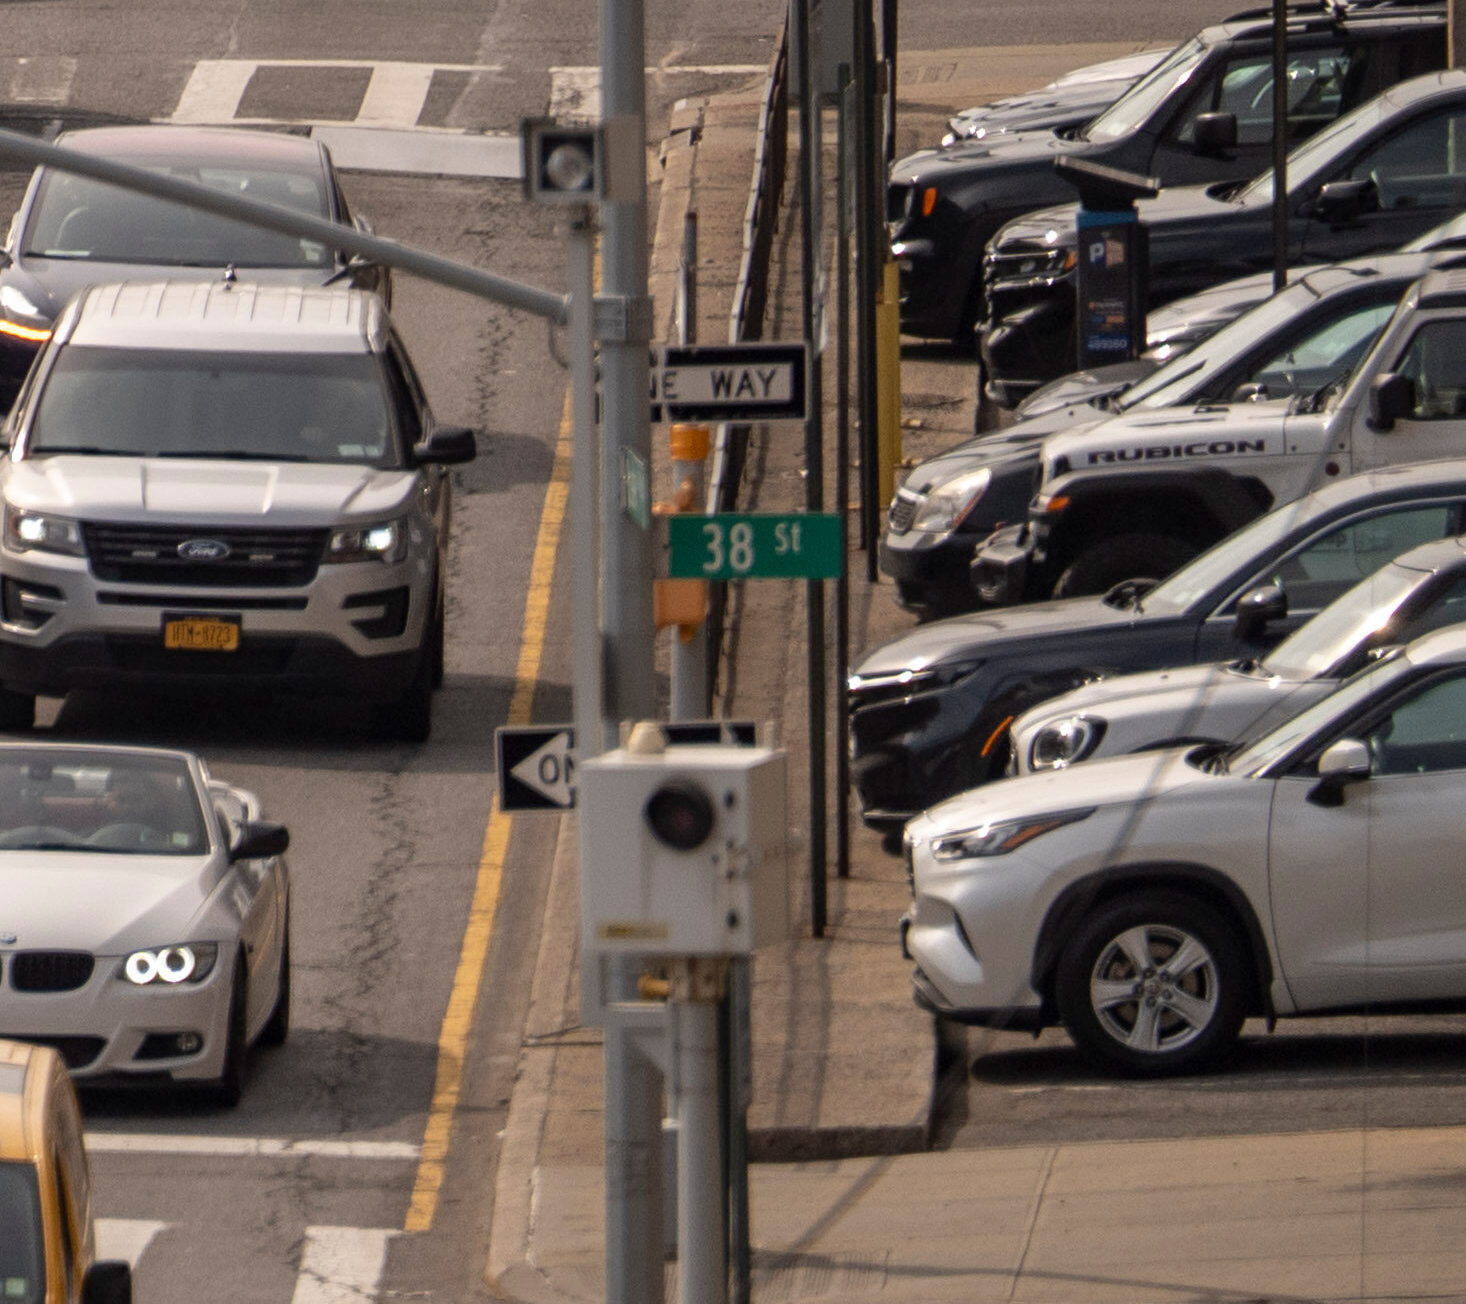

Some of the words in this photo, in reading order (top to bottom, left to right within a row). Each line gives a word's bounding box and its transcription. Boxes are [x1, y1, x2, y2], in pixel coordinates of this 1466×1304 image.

[711, 368, 778, 397] WAY
[1087, 438, 1266, 466] RUBICON
[702, 522, 755, 575] 38
[774, 521, 802, 556] St
